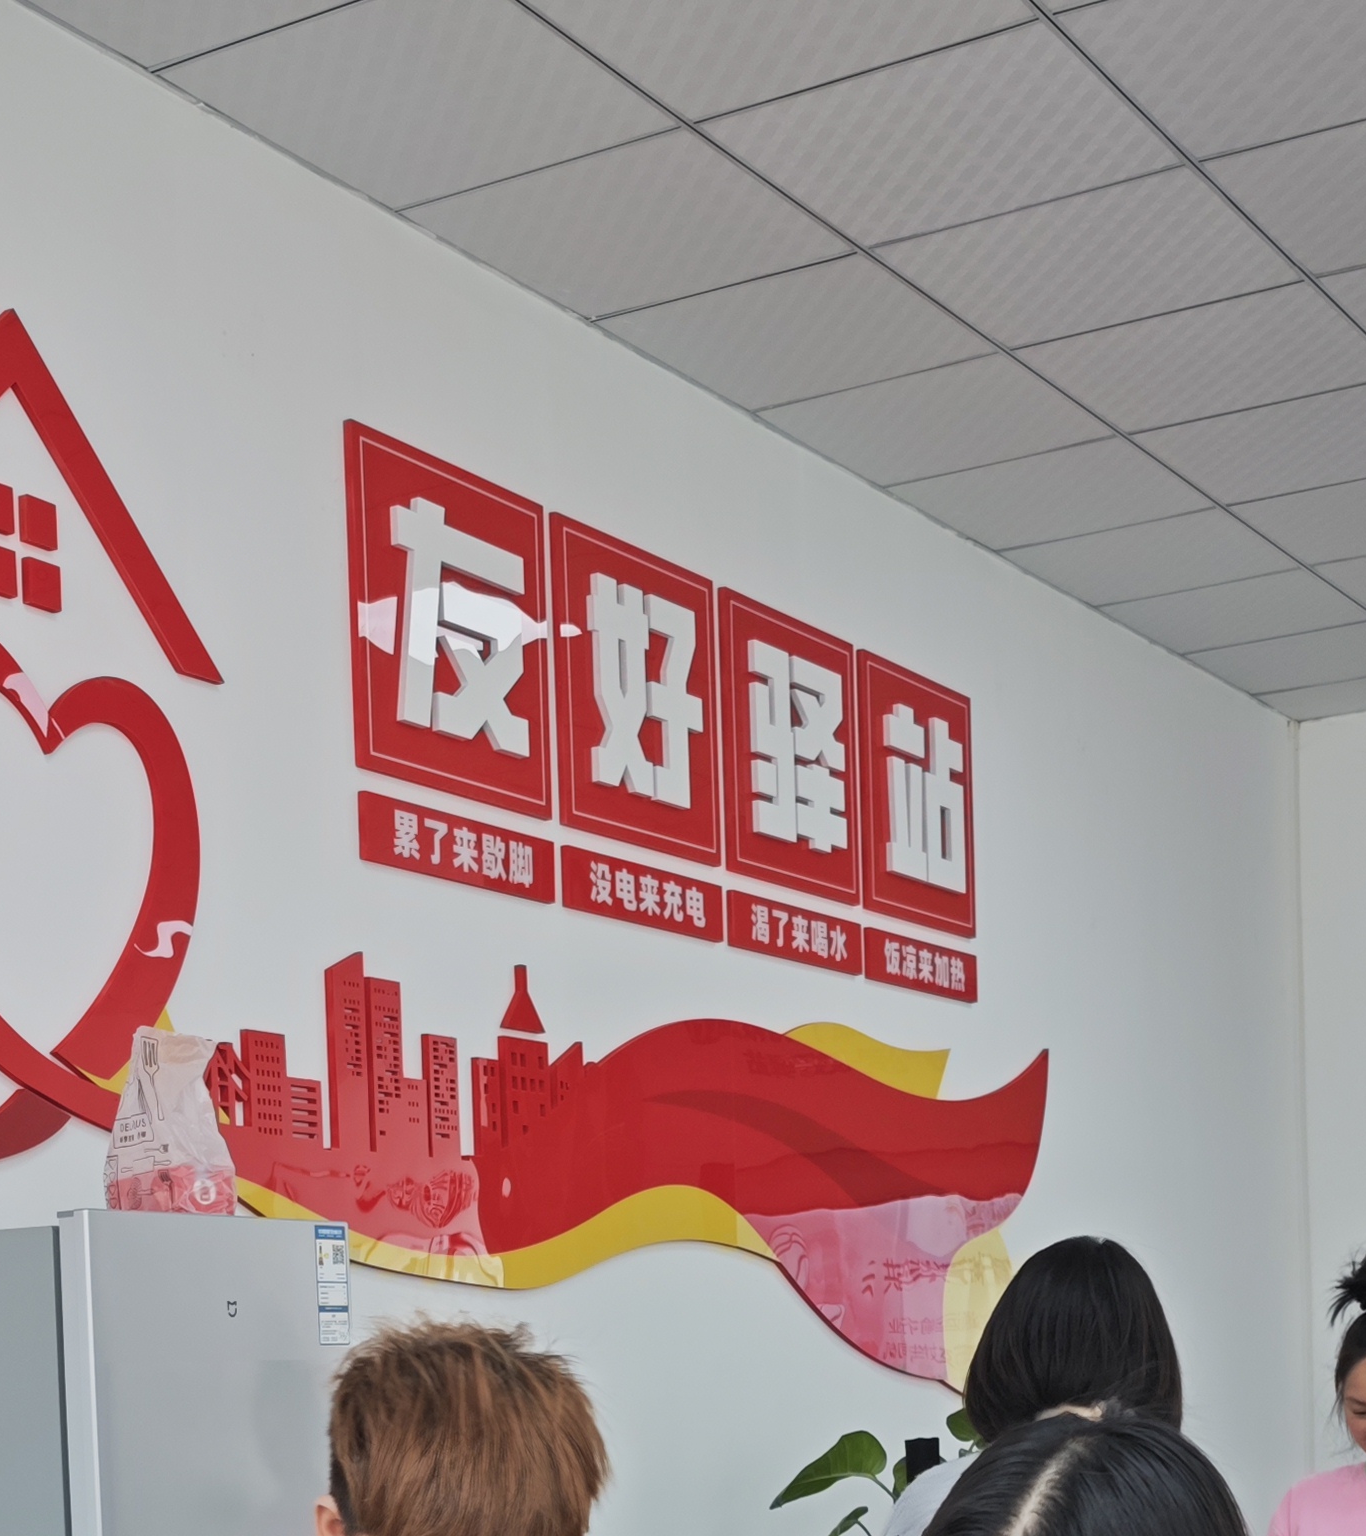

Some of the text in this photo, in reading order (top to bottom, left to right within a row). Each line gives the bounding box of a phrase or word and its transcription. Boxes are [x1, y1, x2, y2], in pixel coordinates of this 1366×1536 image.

[389, 496, 968, 895] 友好驿站
[392, 808, 534, 889] 累了来歇脚
[589, 860, 707, 929] 没电来充电
[750, 902, 848, 962] 渴了来喝水
[884, 938, 966, 993] 饭凉来加热
